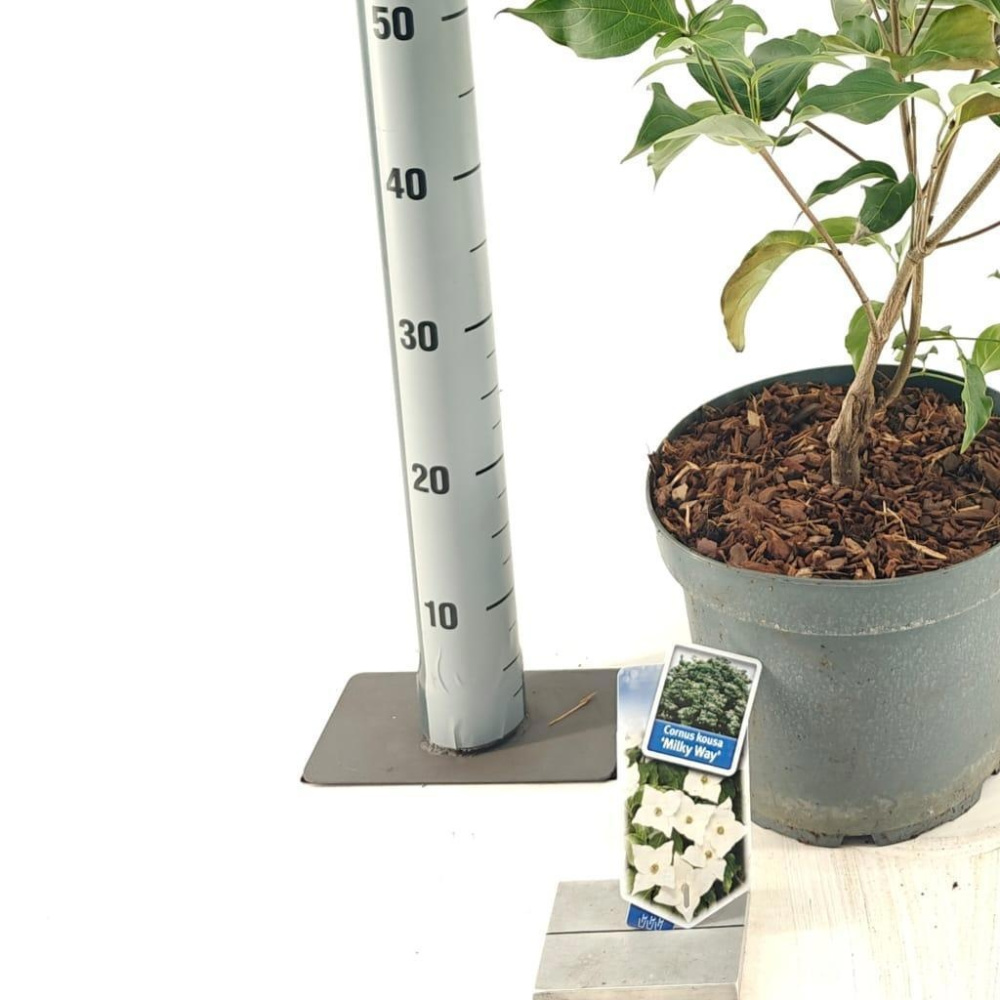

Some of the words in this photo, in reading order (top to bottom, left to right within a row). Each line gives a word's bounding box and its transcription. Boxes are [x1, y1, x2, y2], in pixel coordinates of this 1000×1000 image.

[373, 6, 415, 41] 50
[386, 168, 427, 200] 40
[399, 319, 438, 352] 30
[411, 463, 450, 495] 20
[424, 600, 458, 630] 10
[663, 724, 695, 741] Cornus
[696, 732, 723, 748] kousa
